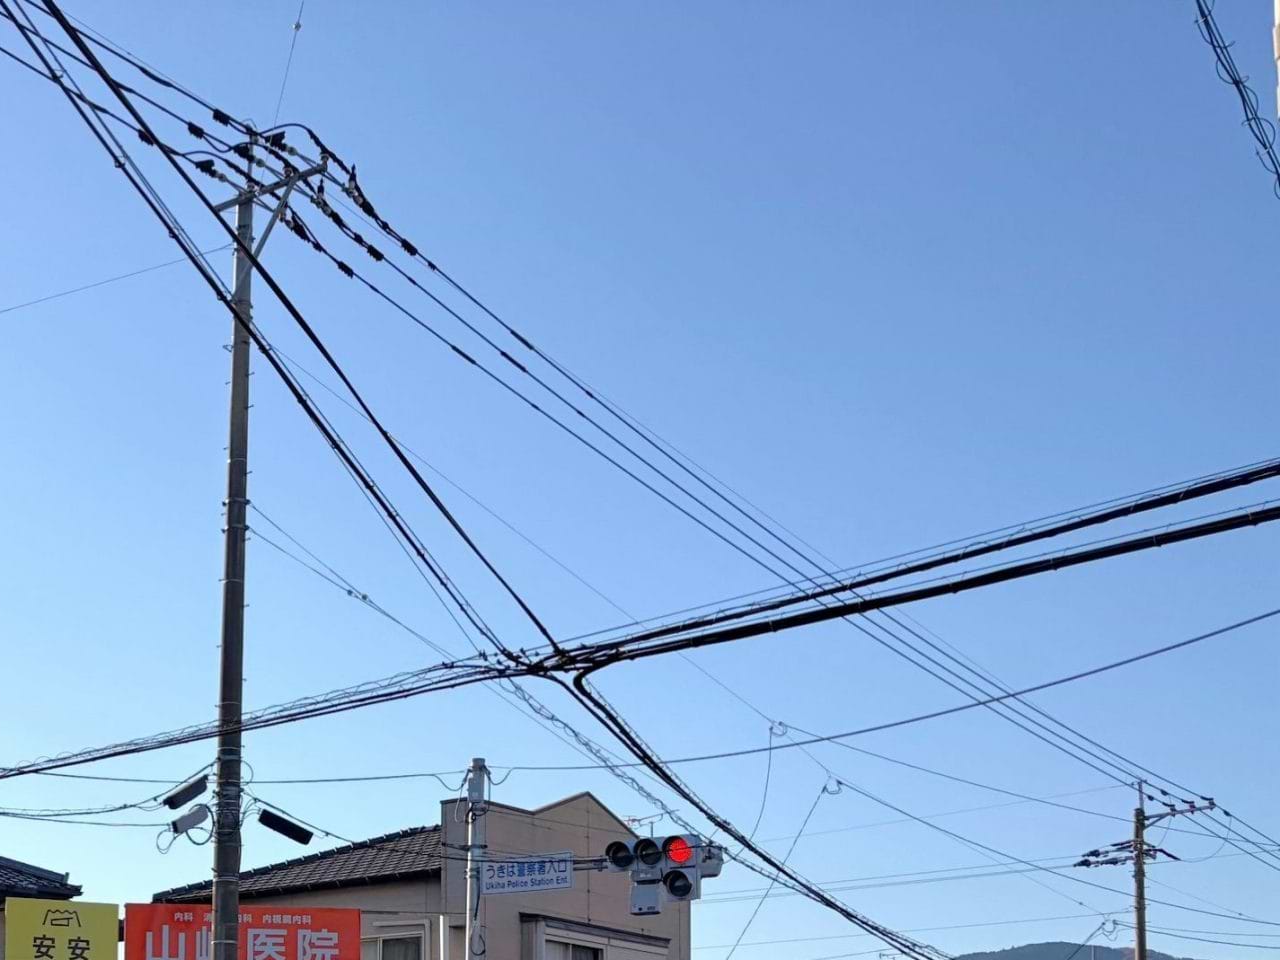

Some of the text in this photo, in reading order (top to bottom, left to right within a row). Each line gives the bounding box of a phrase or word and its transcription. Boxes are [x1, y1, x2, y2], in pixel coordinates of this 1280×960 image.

[485, 881, 506, 890] Ukiha
[507, 879, 528, 888] Police
[530, 877, 554, 887] Station
